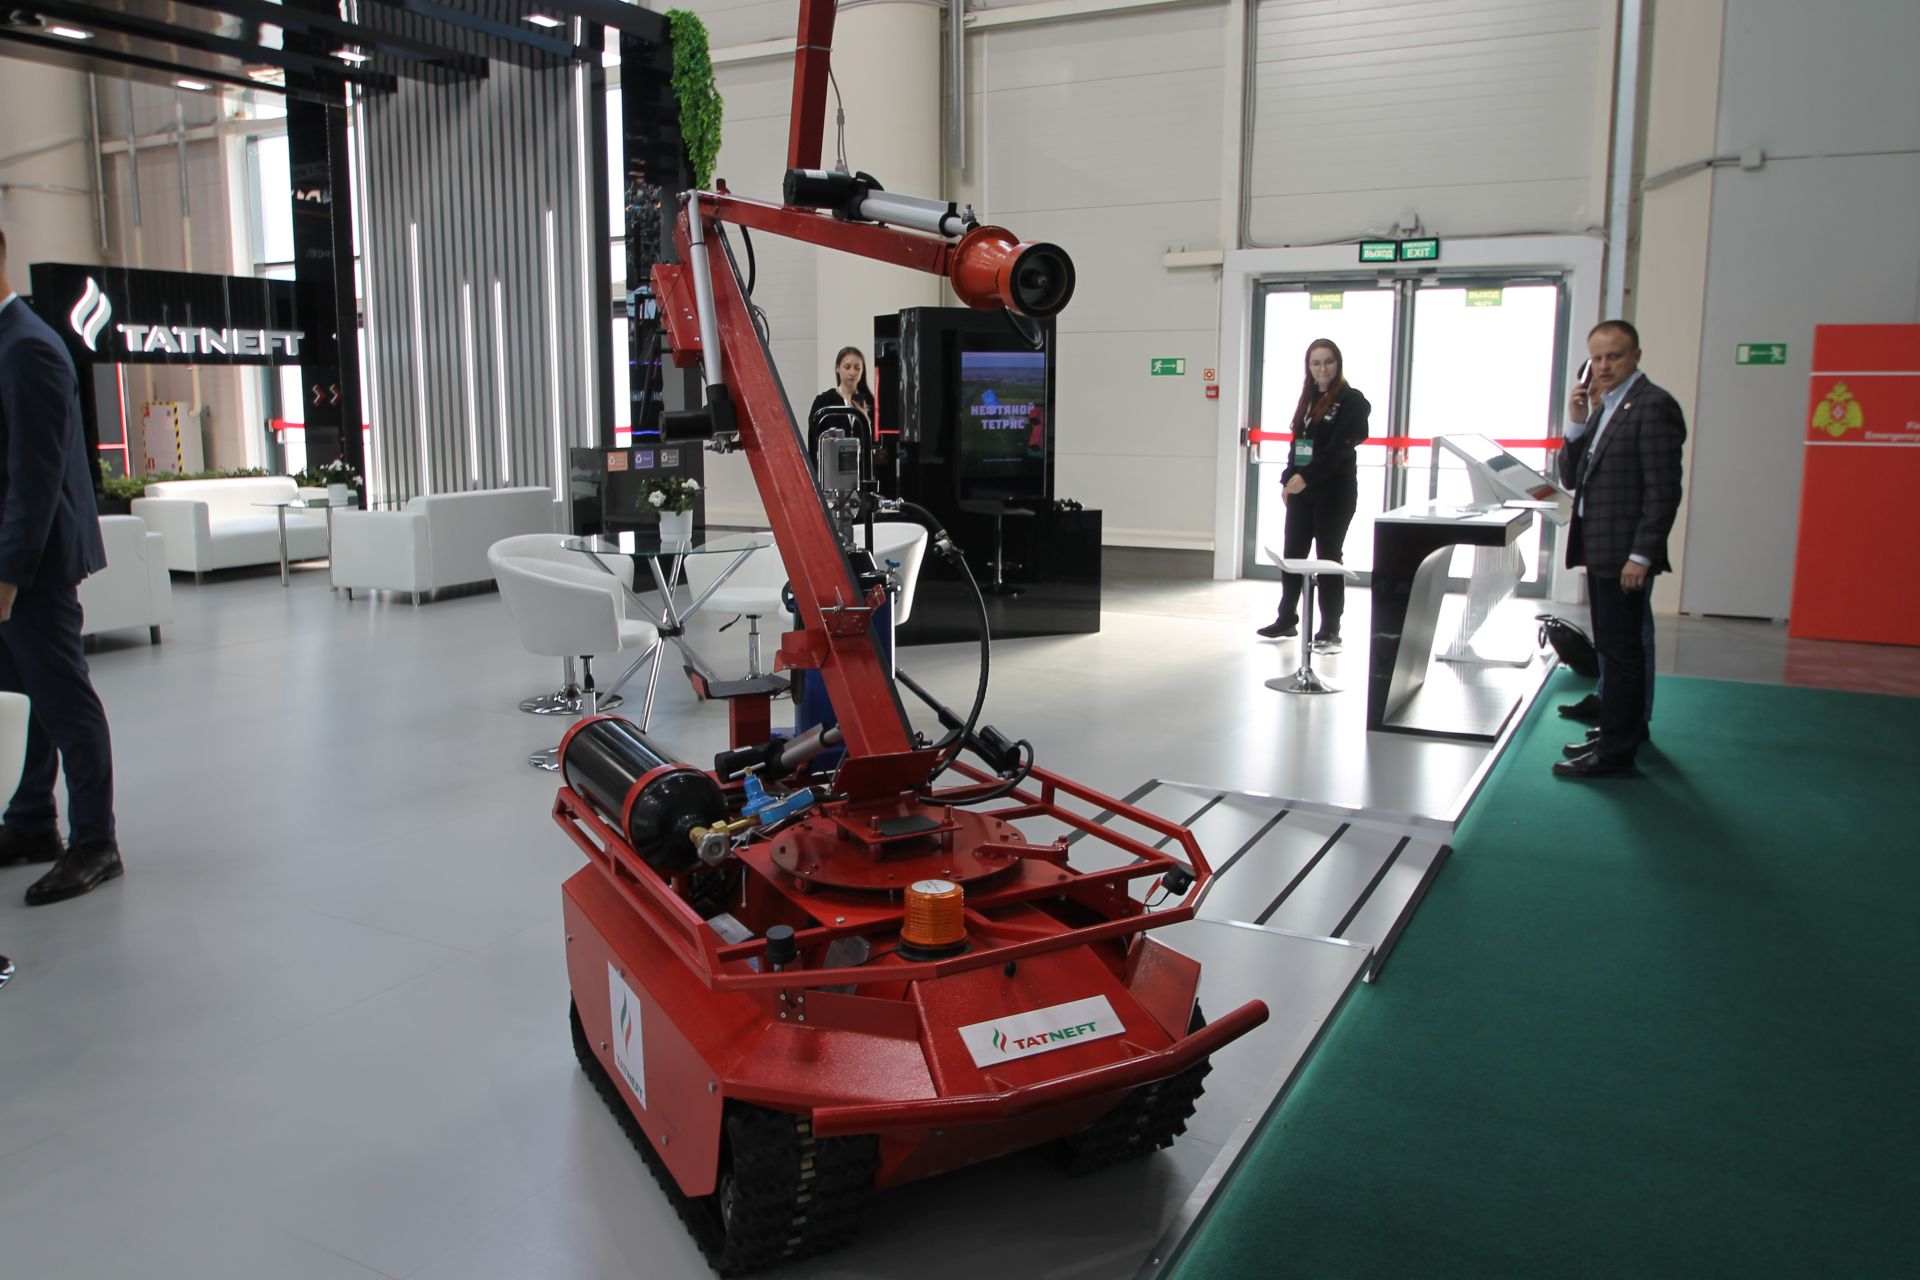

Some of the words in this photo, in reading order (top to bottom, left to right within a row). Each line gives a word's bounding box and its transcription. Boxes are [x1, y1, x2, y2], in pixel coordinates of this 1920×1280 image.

[1363, 248, 1394, 259] ВЫХОД
[1407, 247, 1431, 257] EXIT
[1312, 293, 1341, 303] ВЫХОД
[116, 323, 305, 356] TATNEFT
[980, 418, 1026, 430] ТЕТРИС
[1012, 1021, 1097, 1051] TATNEFT
[616, 1053, 643, 1099] TATNEFT
